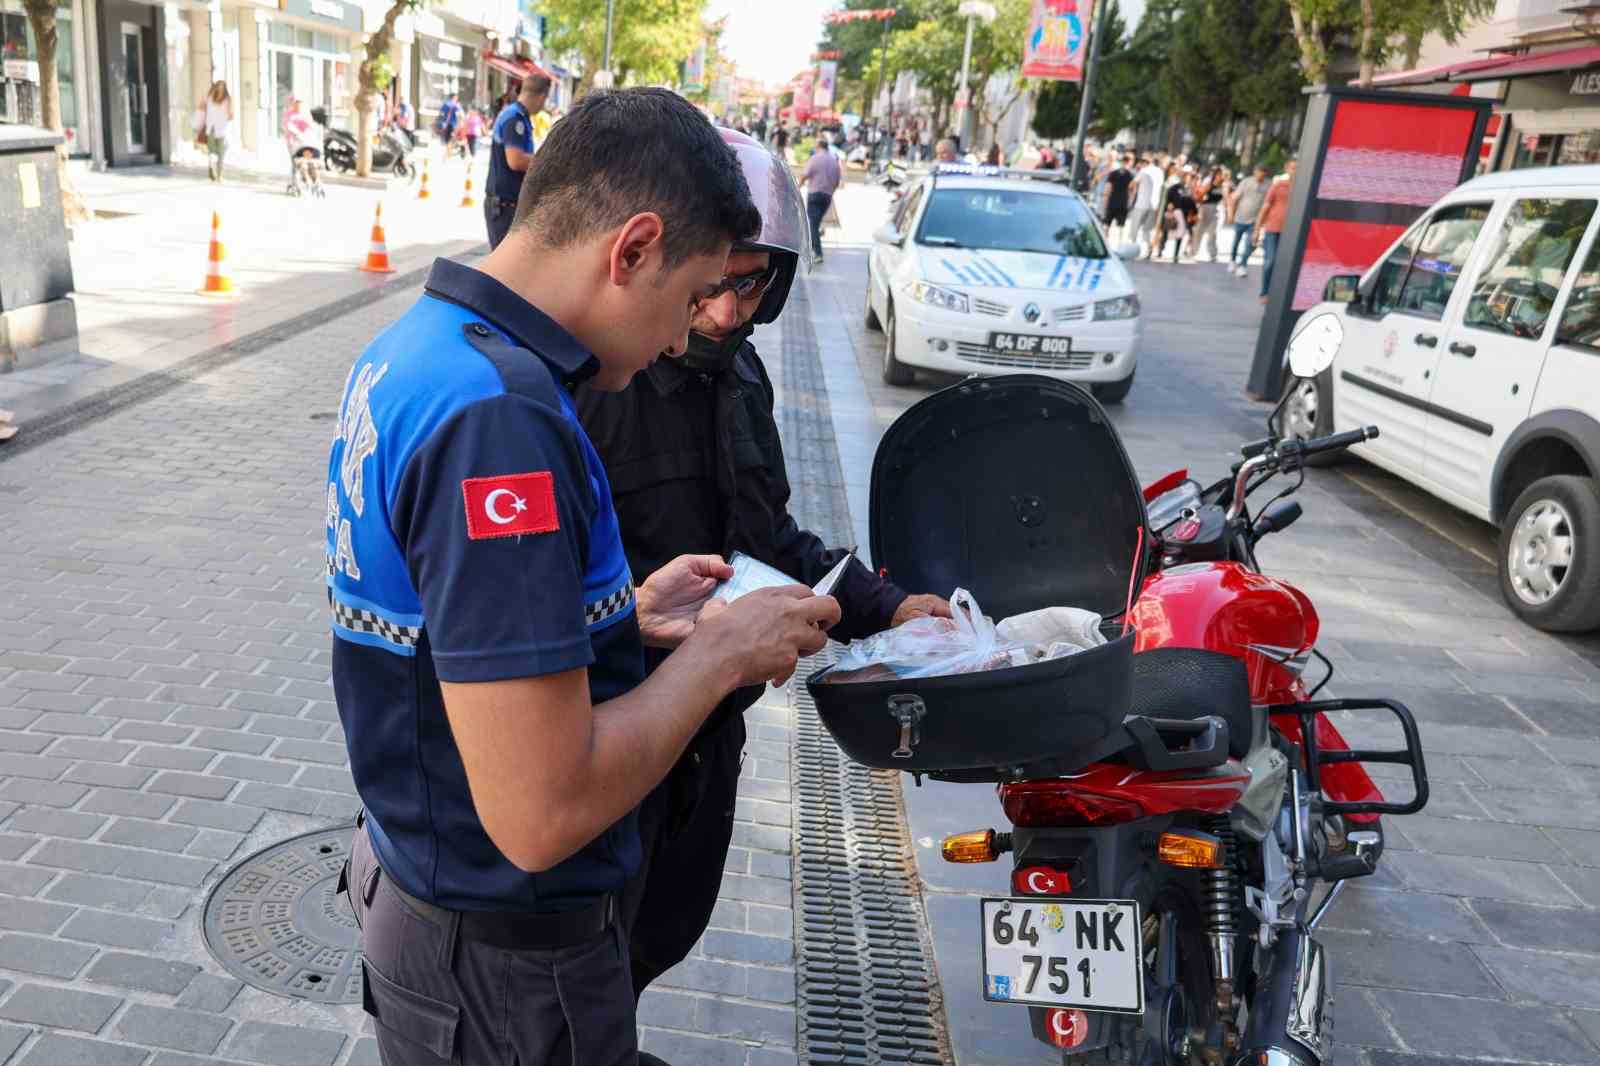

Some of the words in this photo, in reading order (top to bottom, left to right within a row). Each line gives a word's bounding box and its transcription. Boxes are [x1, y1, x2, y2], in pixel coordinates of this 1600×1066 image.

[995, 334, 1014, 350] 64
[1016, 336, 1039, 351] DF
[992, 909, 1039, 947] 64
[1076, 910, 1125, 951] NK
[1022, 955, 1090, 998] 751
